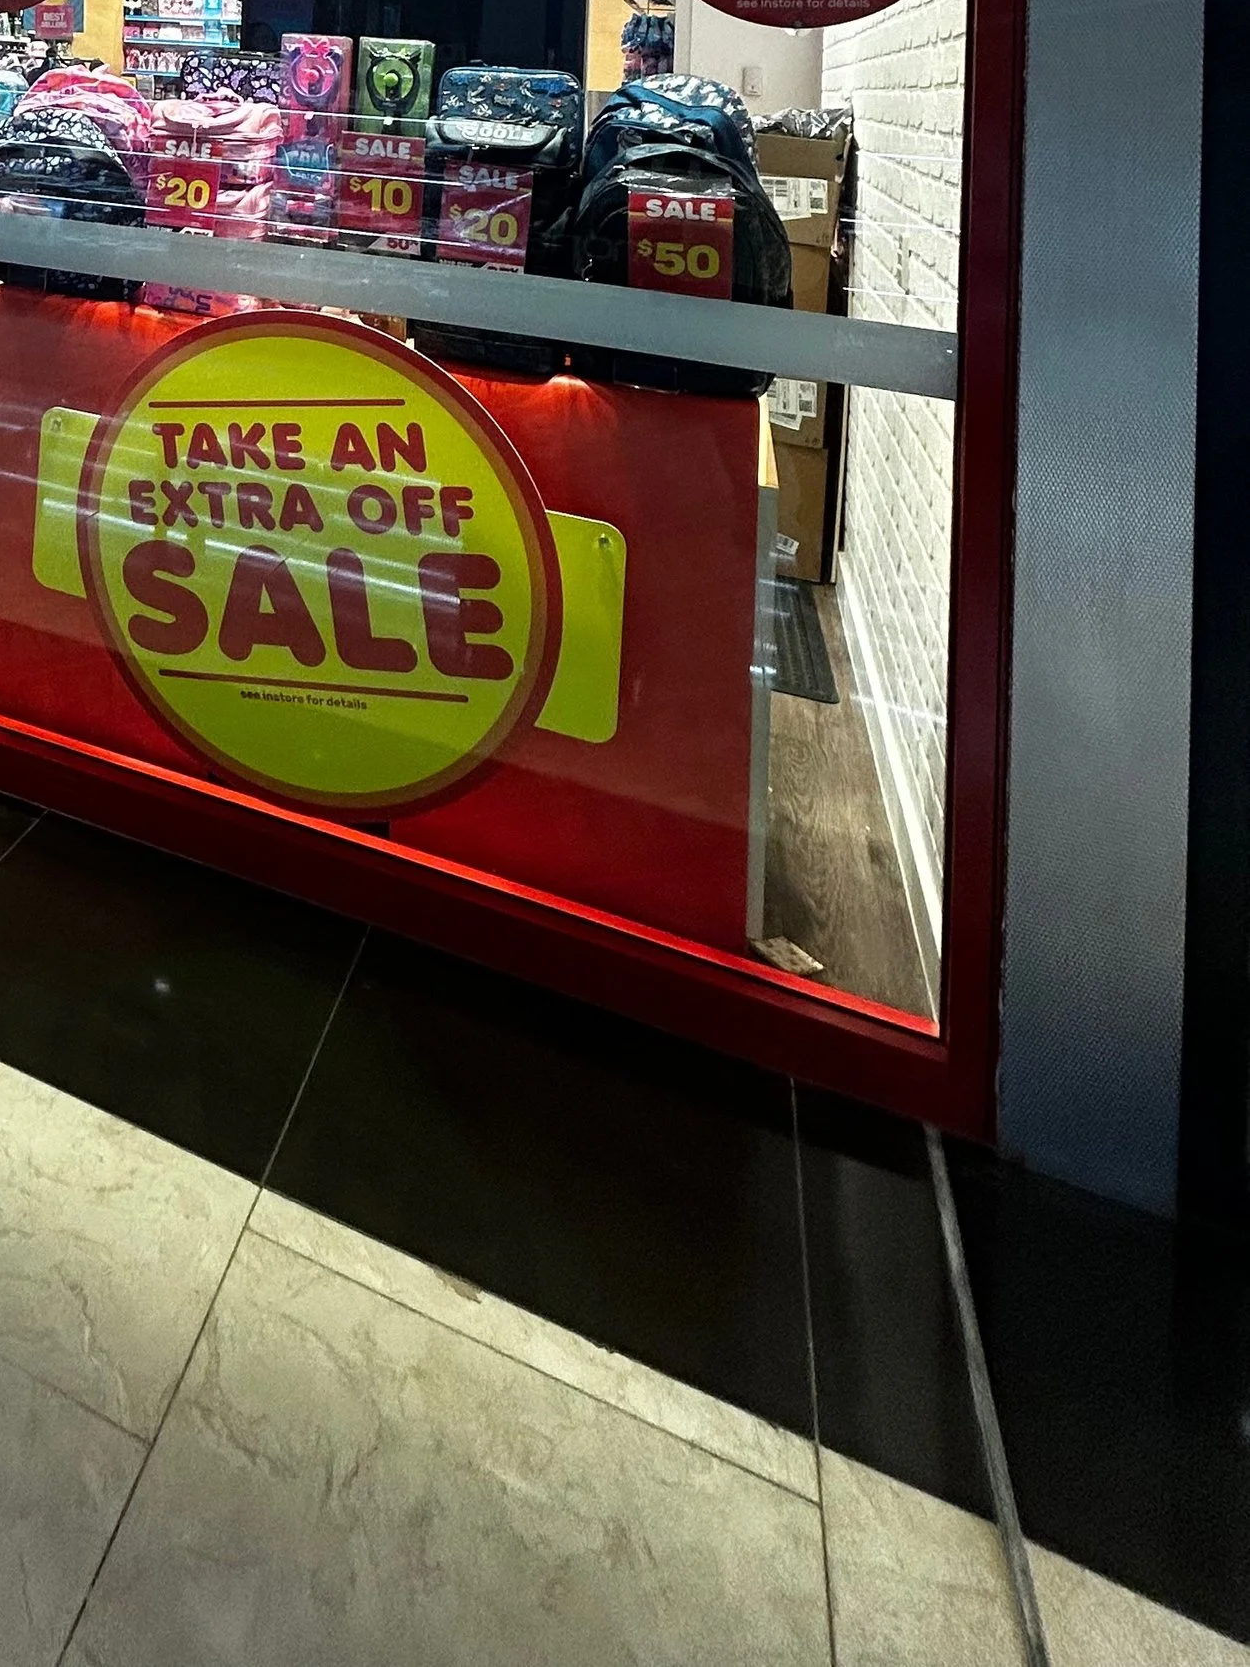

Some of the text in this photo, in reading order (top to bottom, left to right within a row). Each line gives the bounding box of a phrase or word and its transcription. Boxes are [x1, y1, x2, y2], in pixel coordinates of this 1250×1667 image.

[43, 12, 66, 22] BEST
[736, 0, 757, 9] see
[164, 139, 212, 159] SALE
[354, 137, 411, 160] SALE
[156, 174, 210, 210] $20
[458, 165, 519, 191] SALE
[350, 176, 413, 215] $10
[645, 198, 717, 222] SALE
[449, 203, 518, 246] $20
[637, 238, 720, 279] $50
[152, 422, 428, 473] TAKE AN
[127, 480, 475, 537] EXTRA OFF
[122, 539, 515, 681] SALE
[240, 690, 368, 711] see instore for details
